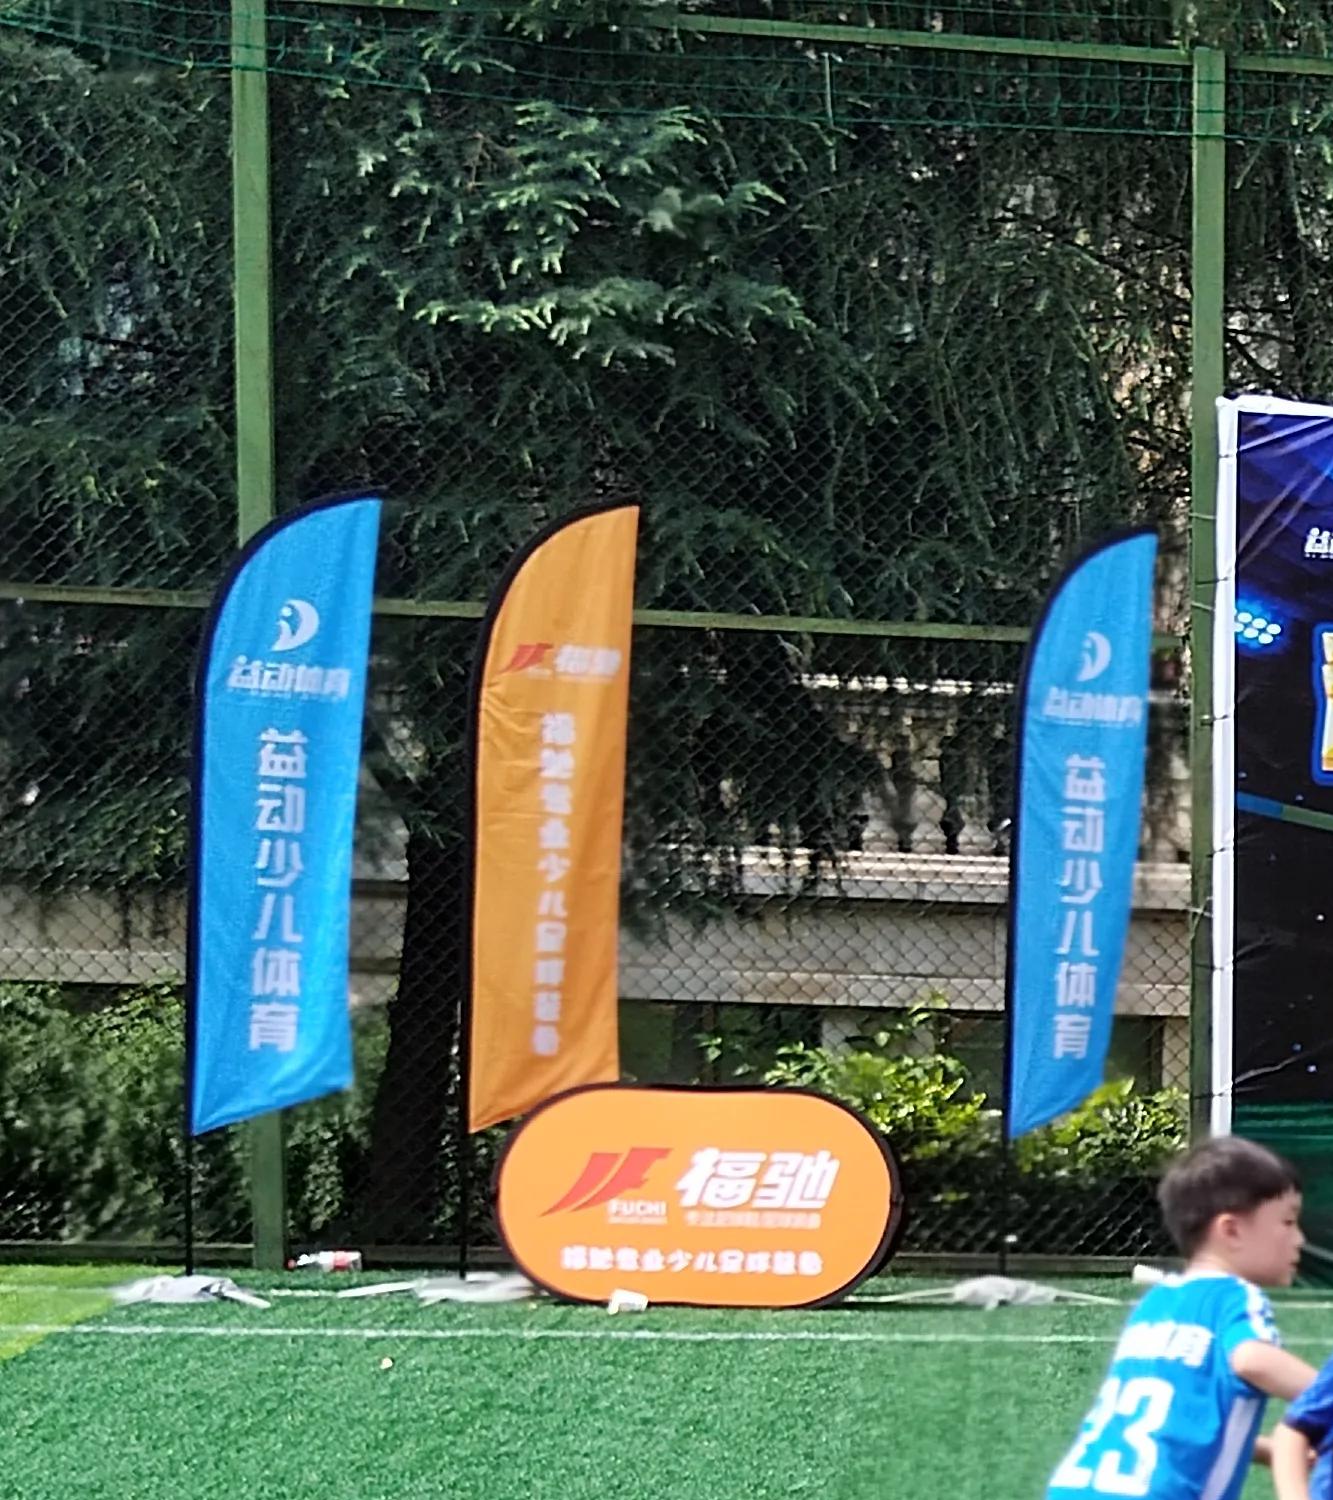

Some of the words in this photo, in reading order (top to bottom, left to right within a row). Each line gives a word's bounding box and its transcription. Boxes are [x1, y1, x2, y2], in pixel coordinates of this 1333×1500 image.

[226, 654, 351, 699] 益动体育
[248, 728, 308, 1054] 益动少儿体育
[1052, 752, 1107, 1060] 益动少儿体育
[608, 1200, 667, 1216] FUCHI
[675, 1147, 840, 1210] 福驰
[1048, 1376, 1174, 1497] 23
